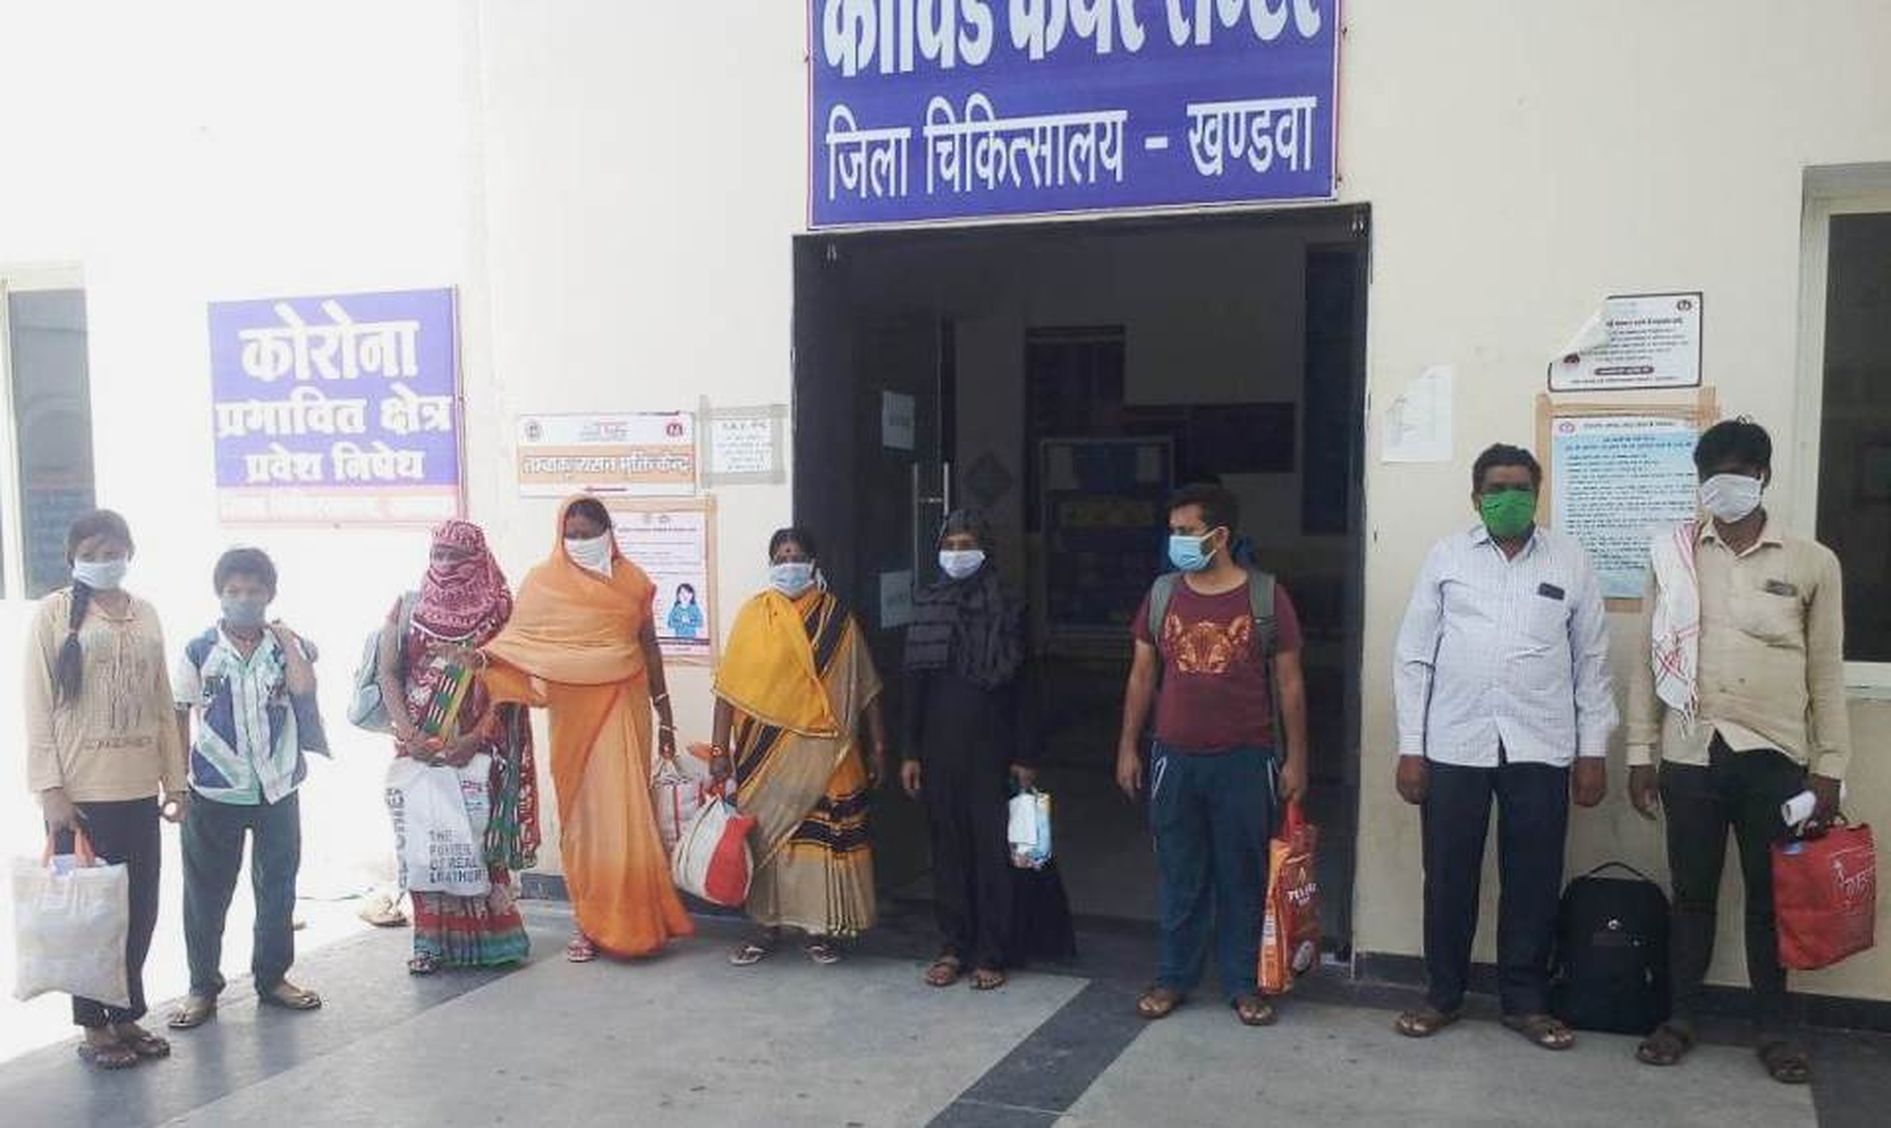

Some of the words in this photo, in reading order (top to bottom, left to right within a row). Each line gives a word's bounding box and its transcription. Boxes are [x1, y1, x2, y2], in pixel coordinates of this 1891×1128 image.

[1010, 0, 1144, 59] कयर
[826, 105, 911, 200] जिला
[923, 93, 1127, 193] चिकित्सालय
[1187, 97, 1316, 175] खण्डवा
[239, 300, 420, 381] कोरोना
[215, 386, 367, 438] प्रभावित
[380, 383, 452, 434] क्षेत्र
[245, 443, 323, 483] प्रवेश
